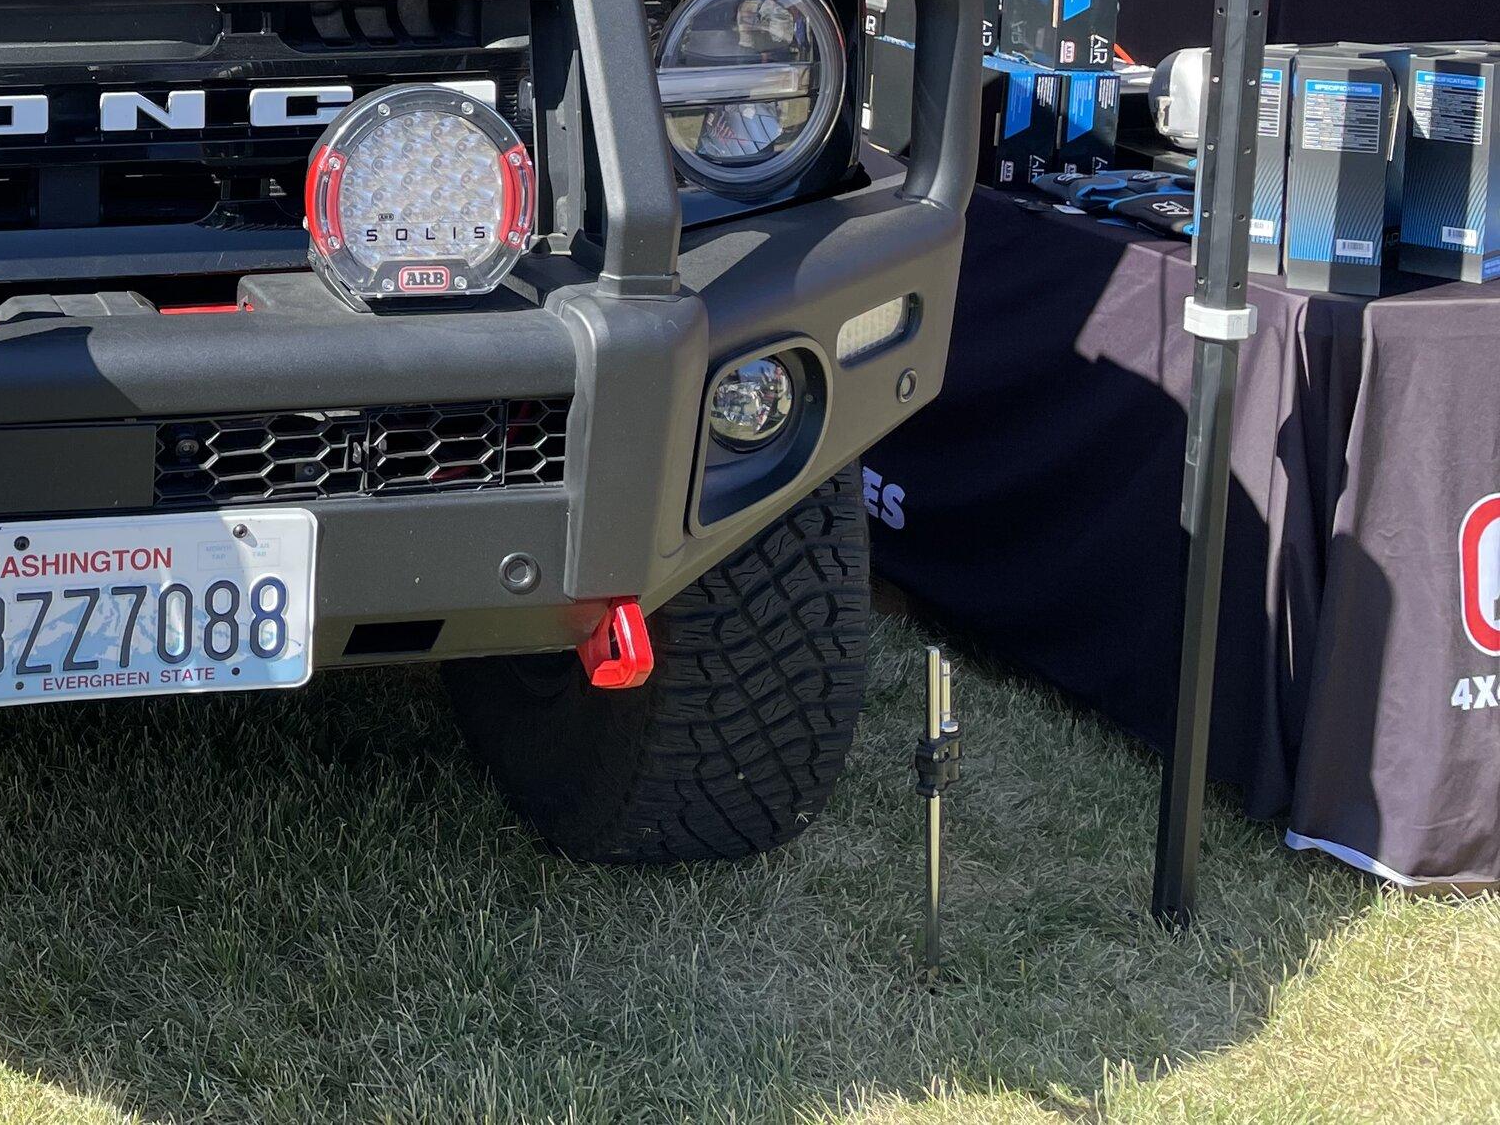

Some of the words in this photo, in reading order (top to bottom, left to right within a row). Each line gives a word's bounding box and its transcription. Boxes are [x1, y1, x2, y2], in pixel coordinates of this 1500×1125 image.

[1092, 34, 1109, 65] AIR
[1424, 74, 1477, 87] SPECIFICATIONS
[366, 226, 486, 242] SOLIS
[405, 272, 445, 286] ARB
[43, 671, 150, 692] EVERGREEN
[160, 666, 216, 684] STATE
[1450, 674, 1500, 712] 4X
